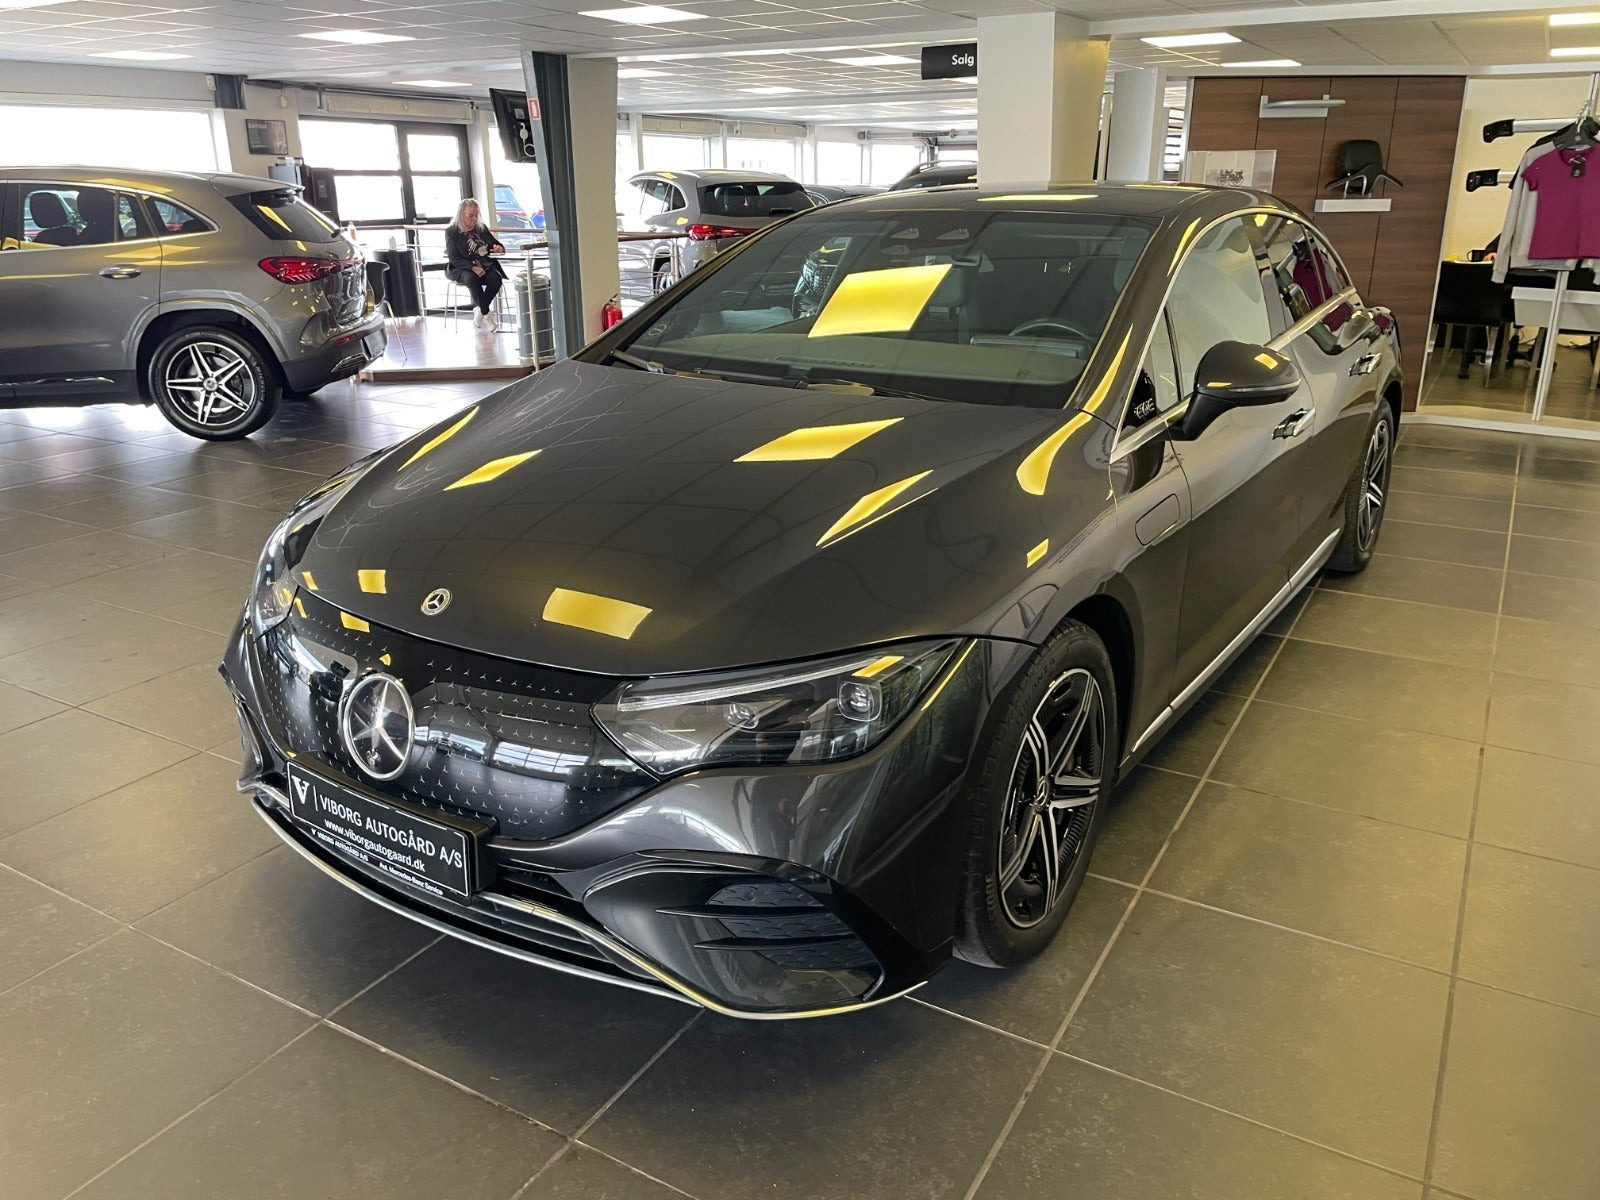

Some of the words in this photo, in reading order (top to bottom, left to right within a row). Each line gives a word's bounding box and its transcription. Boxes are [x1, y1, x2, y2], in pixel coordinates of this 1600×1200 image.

[952, 53, 974, 67] Salg
[319, 795, 363, 827] VIBORG
[365, 817, 436, 857] AUTOGÅRD
[439, 846, 463, 869] A/S
[324, 819, 426, 873] www.viborgautogaard.dk
